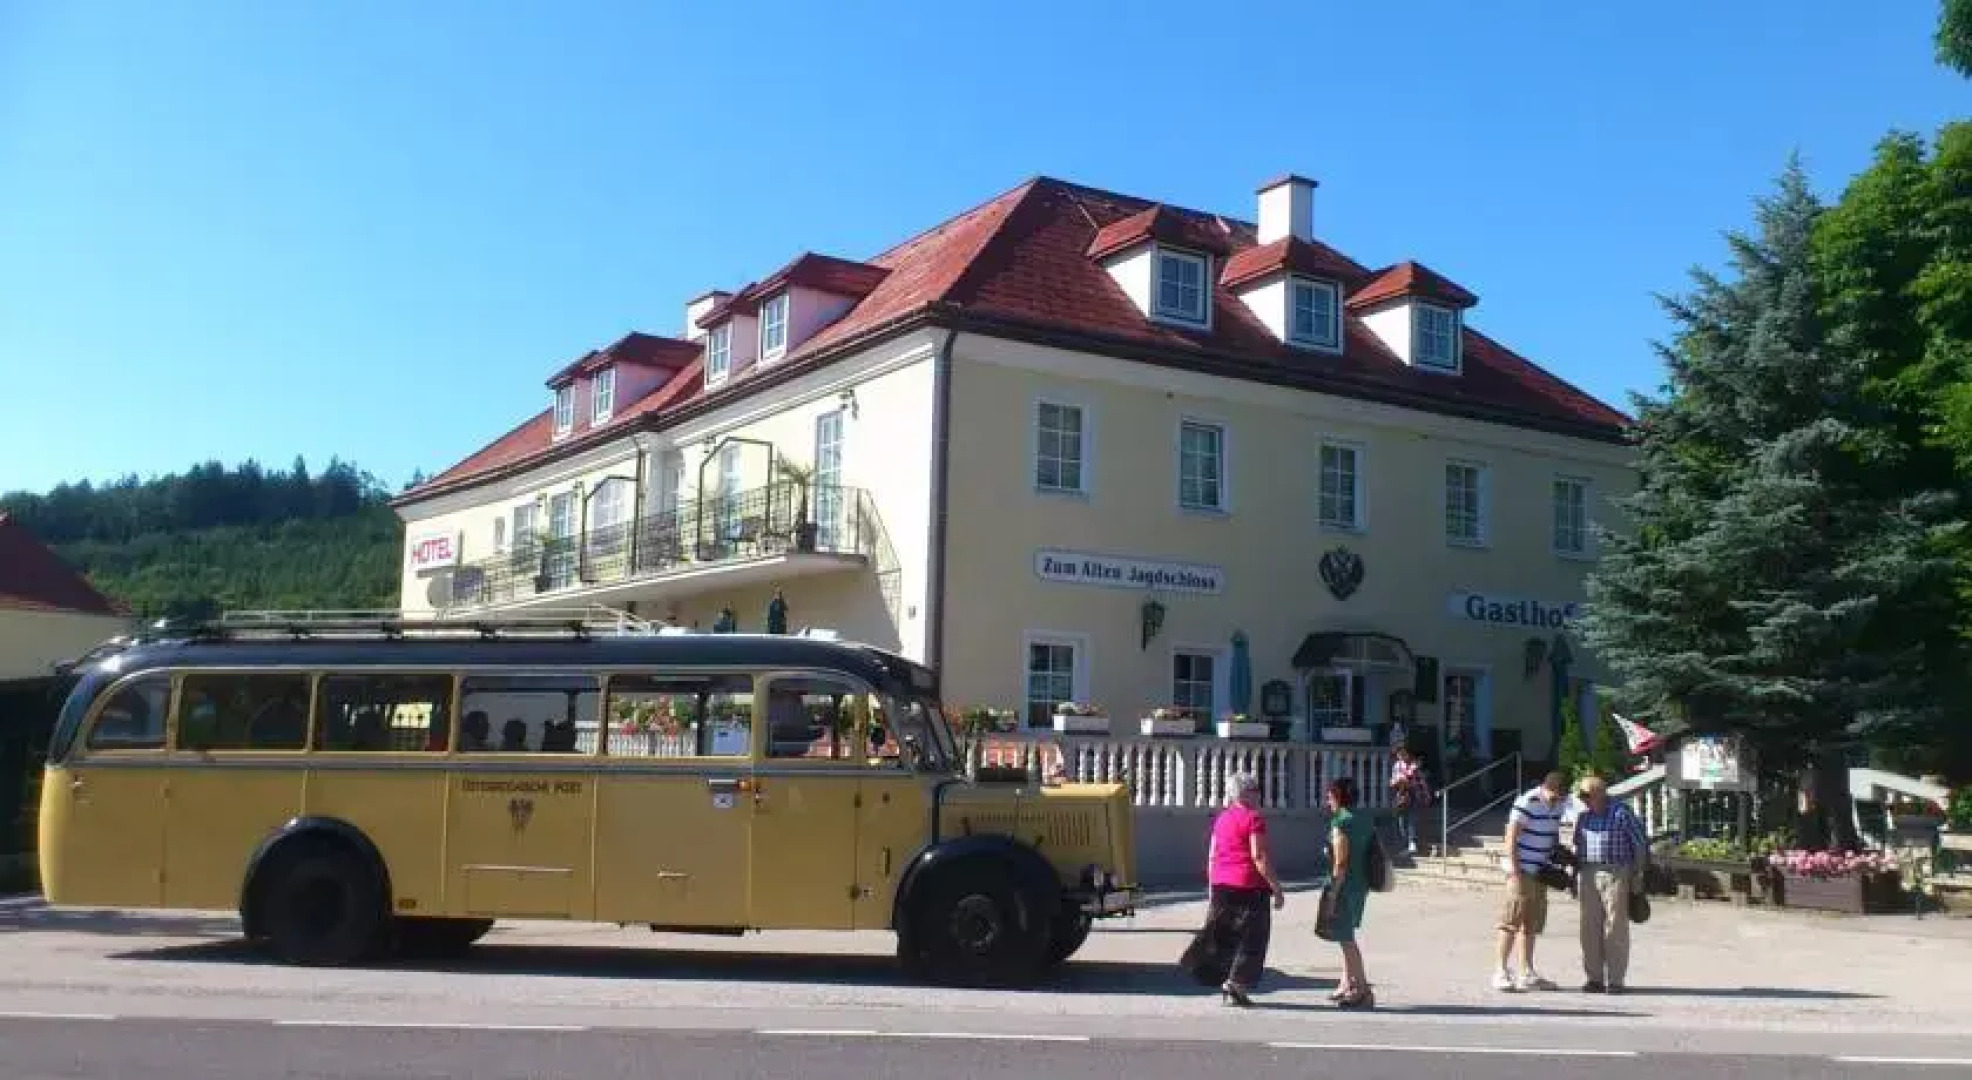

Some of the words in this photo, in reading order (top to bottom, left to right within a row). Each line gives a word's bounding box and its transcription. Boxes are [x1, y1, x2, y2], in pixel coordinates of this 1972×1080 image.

[412, 538, 452, 564] HOTEL
[1043, 556, 1076, 575] Zum
[1081, 561, 1121, 579] Alten
[1127, 566, 1216, 589] Jagdschloss
